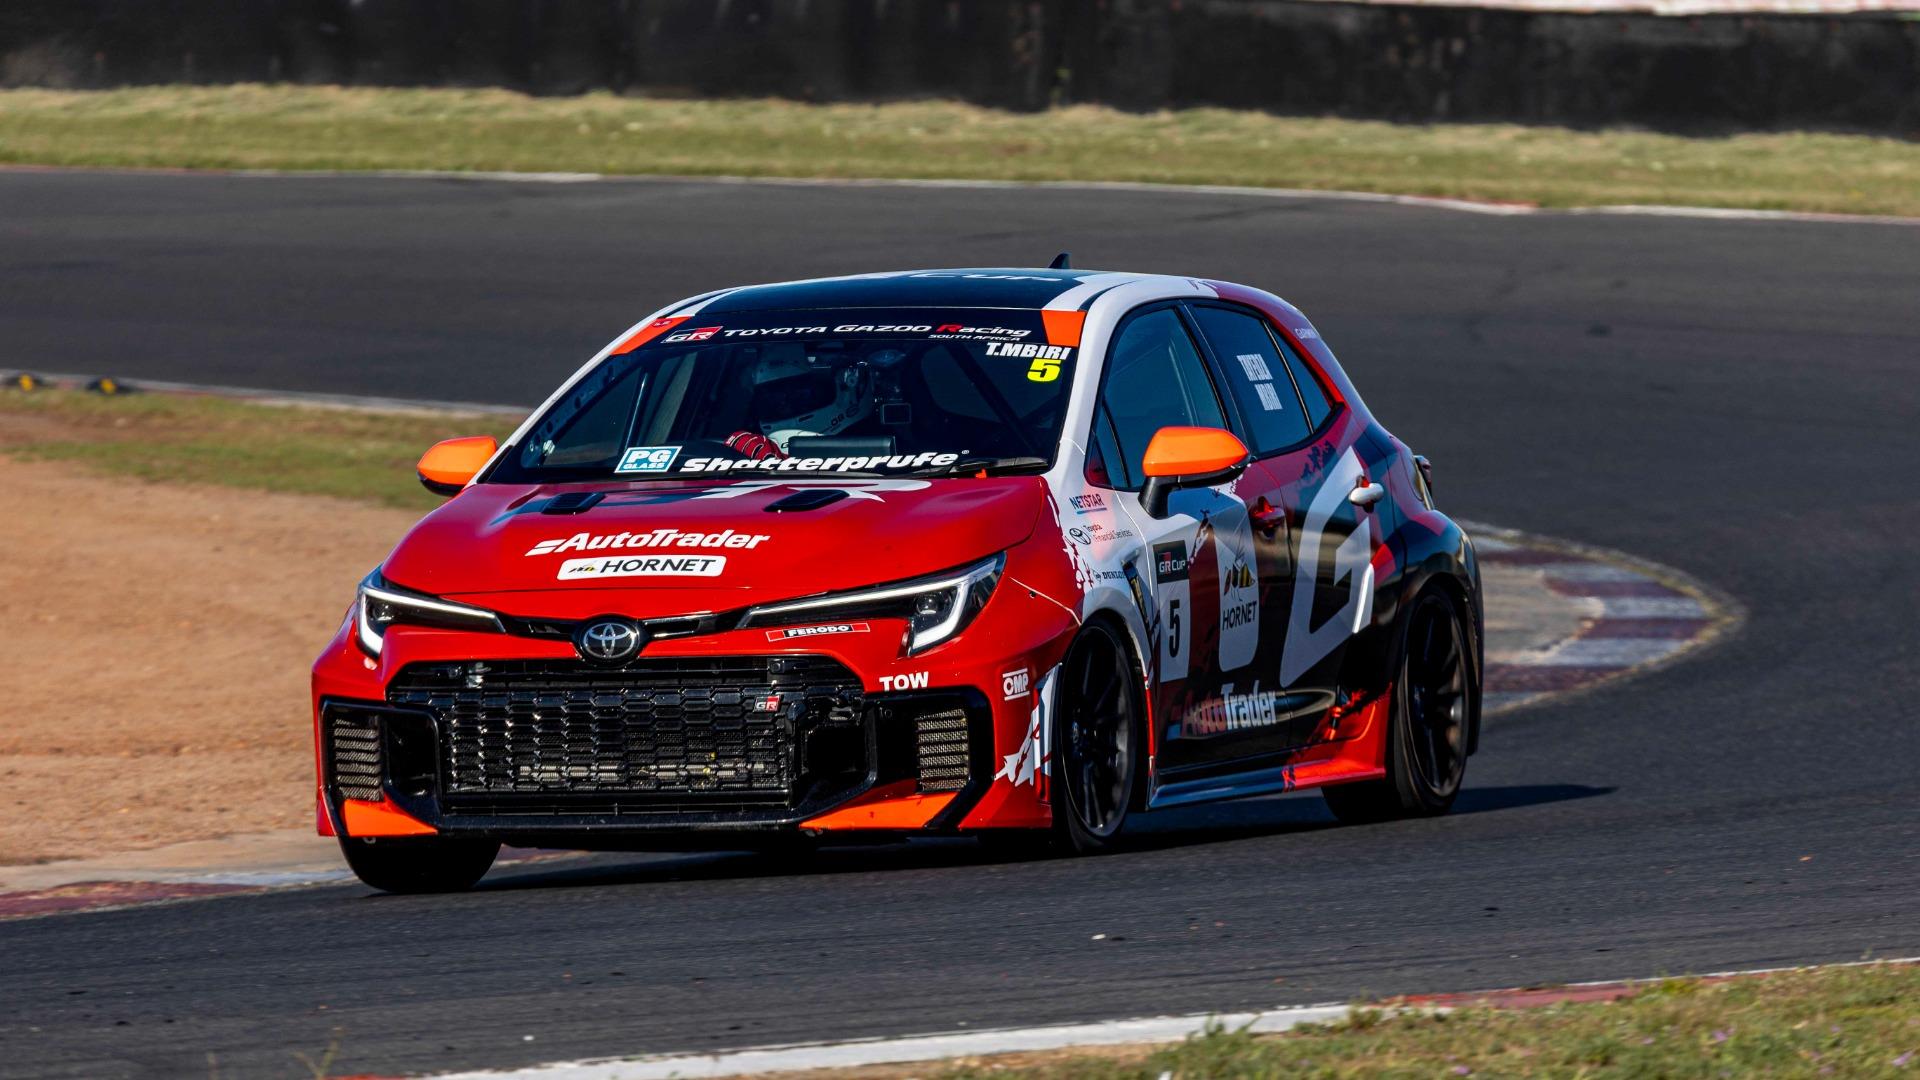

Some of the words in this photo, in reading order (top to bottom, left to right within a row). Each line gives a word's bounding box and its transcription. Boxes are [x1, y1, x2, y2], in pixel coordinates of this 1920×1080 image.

[667, 330, 714, 343] GR
[724, 326, 829, 337] TOYOTA
[833, 324, 933, 333] GAZOO
[937, 323, 1032, 337] Racing
[986, 342, 1072, 360] T.MBIRI
[1027, 358, 1062, 382] 5
[627, 449, 672, 464] PG
[1069, 493, 1105, 510] NETSTAR
[556, 529, 771, 551] AutoTrader
[601, 558, 715, 574] HORNET
[1159, 559, 1171, 574] GR
[1222, 601, 1257, 631] HORNET
[788, 624, 850, 638] FERODO
[1169, 600, 1180, 658] 5
[879, 671, 929, 692] TOW
[1003, 673, 1029, 696] OMP
[755, 697, 777, 712] GR
[1182, 680, 1278, 737] AutoTrader
